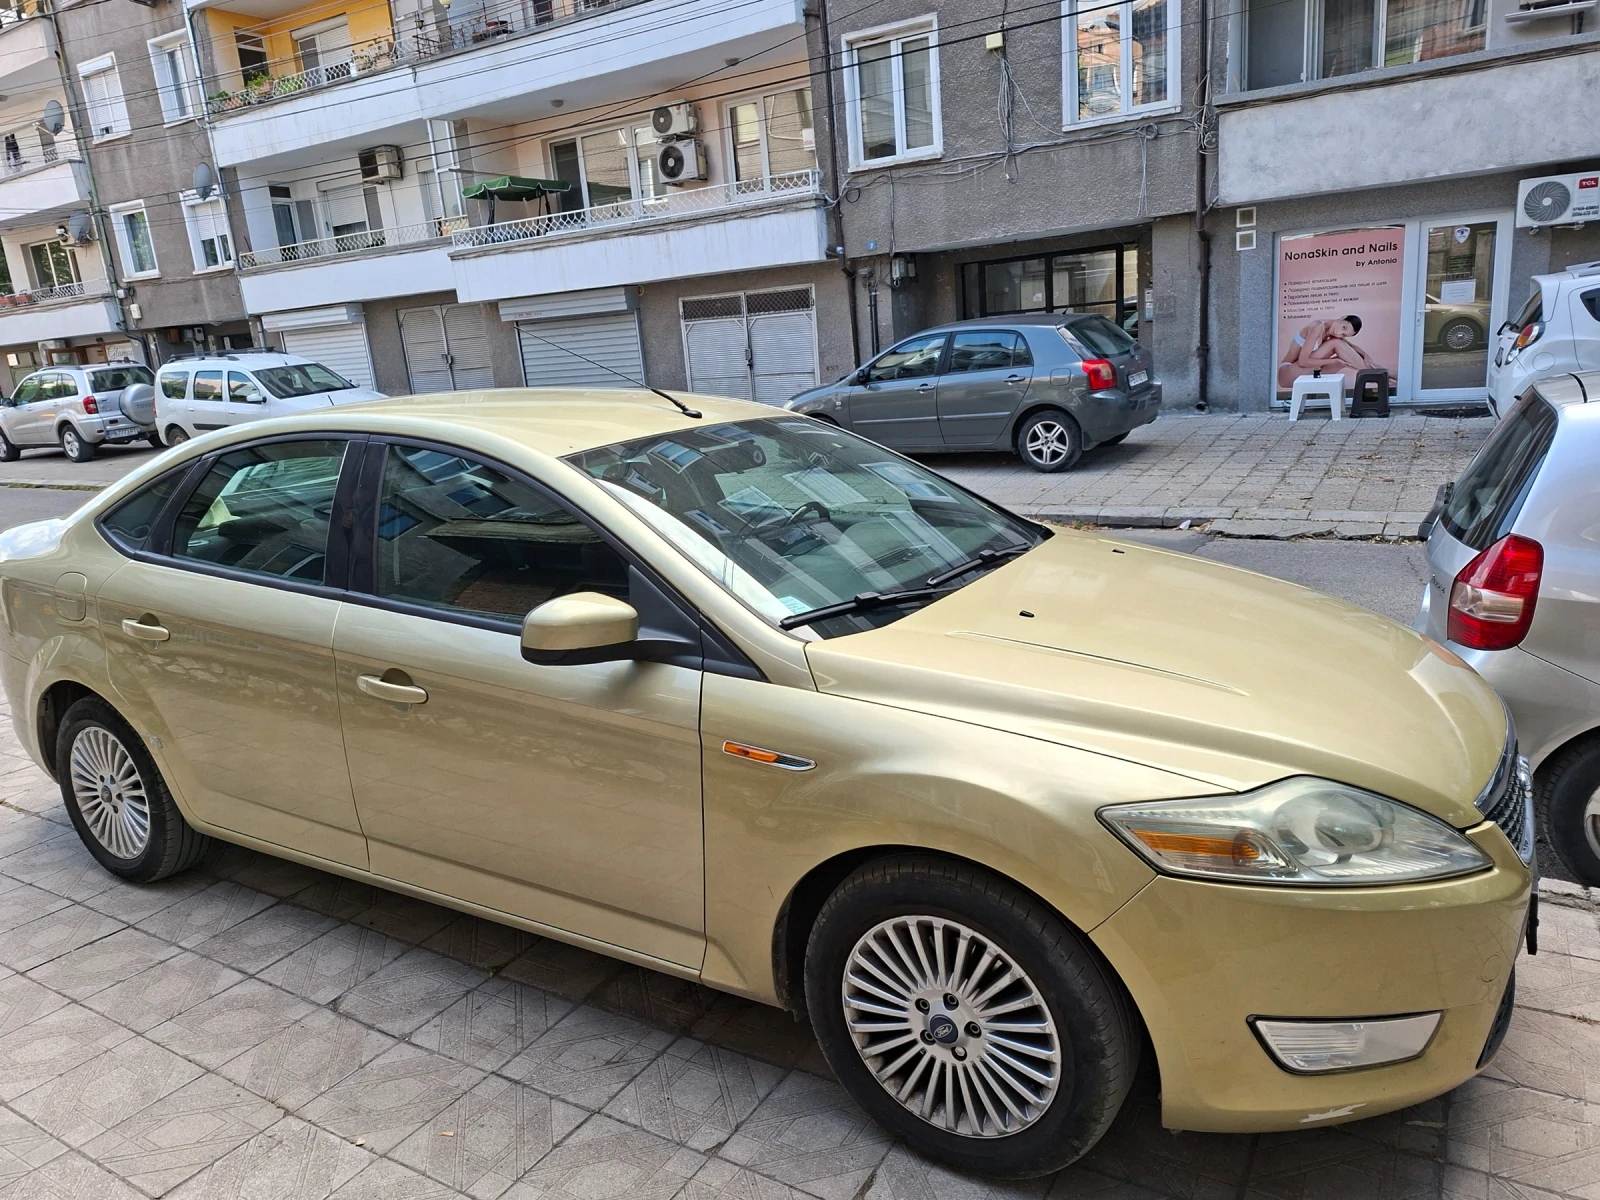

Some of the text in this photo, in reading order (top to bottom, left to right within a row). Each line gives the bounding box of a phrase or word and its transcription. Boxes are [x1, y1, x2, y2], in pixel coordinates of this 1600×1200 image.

[1284, 242, 1398, 261] NonaSkin and Nails
[1367, 257, 1398, 266] Antonia
